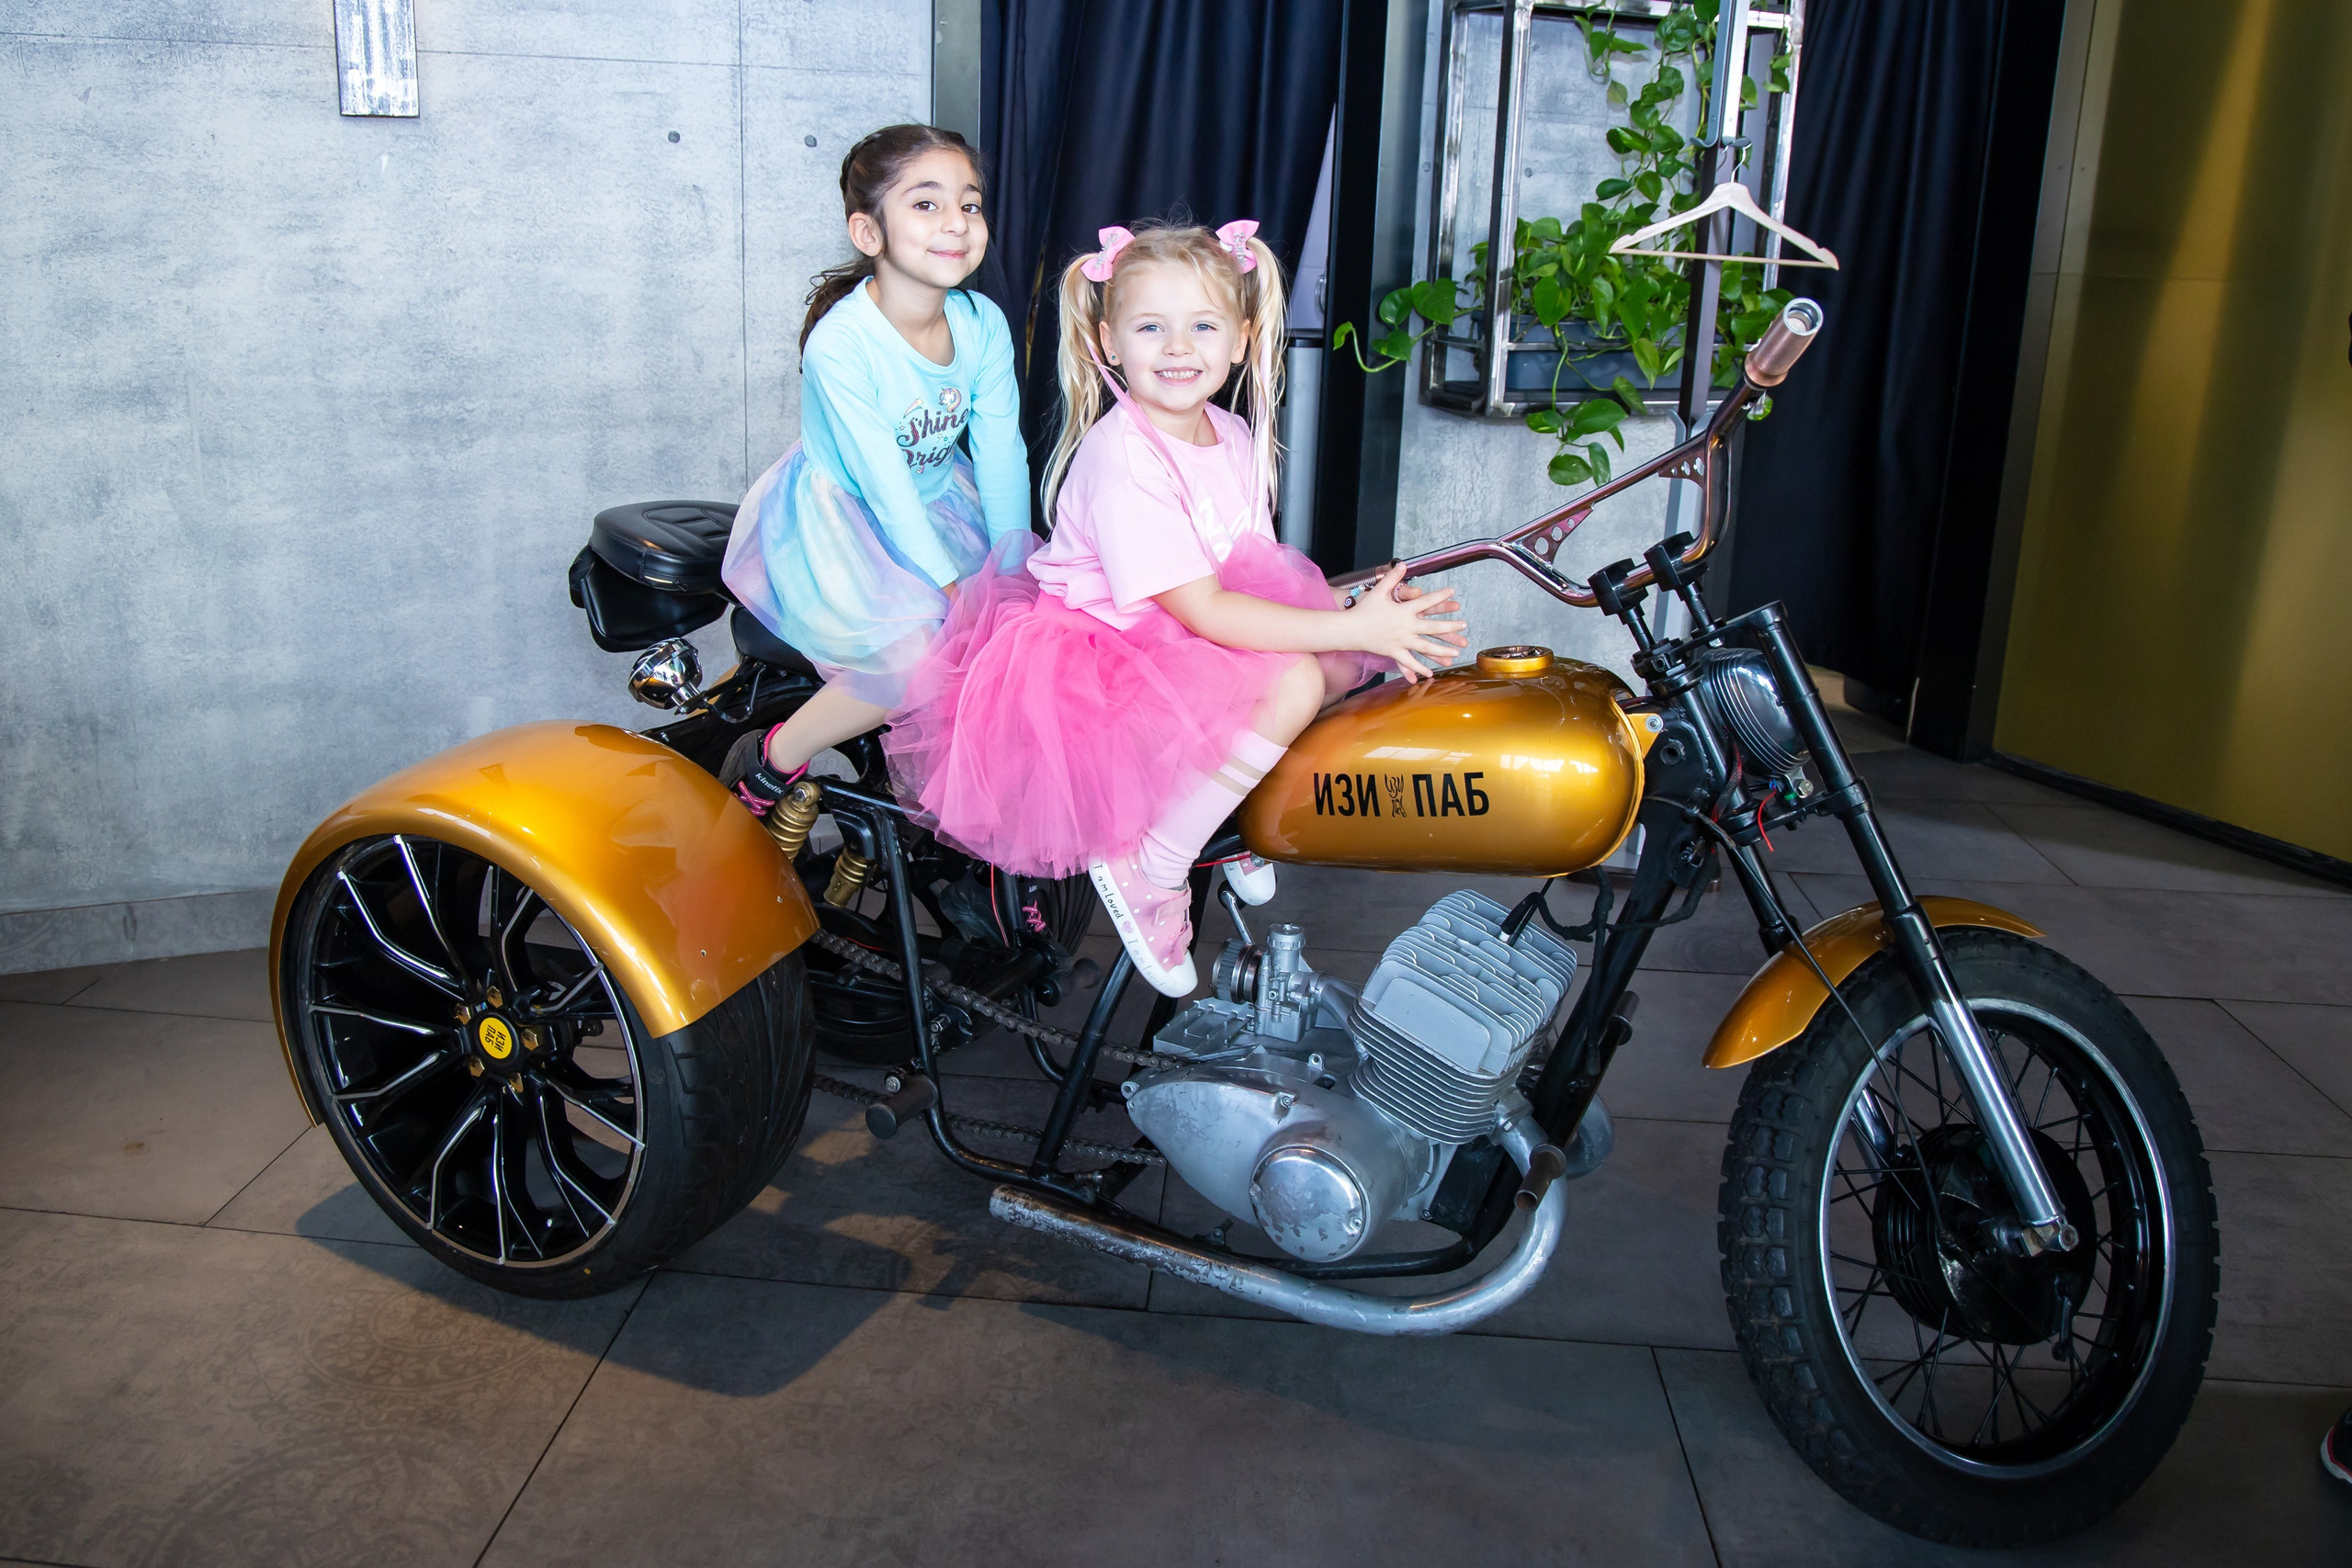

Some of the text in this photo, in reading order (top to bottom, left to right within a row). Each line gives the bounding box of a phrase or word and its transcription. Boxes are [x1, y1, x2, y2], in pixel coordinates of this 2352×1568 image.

[897, 408, 969, 447] Shine
[755, 773, 784, 795] kinetix
[1314, 772, 1490, 817] ИЗИ ПАБ
[1104, 893, 1125, 919] loved
[1143, 964, 1166, 986] lovd
[484, 1024, 496, 1045] ПАБ
[494, 1031, 506, 1053] ИЗИ
